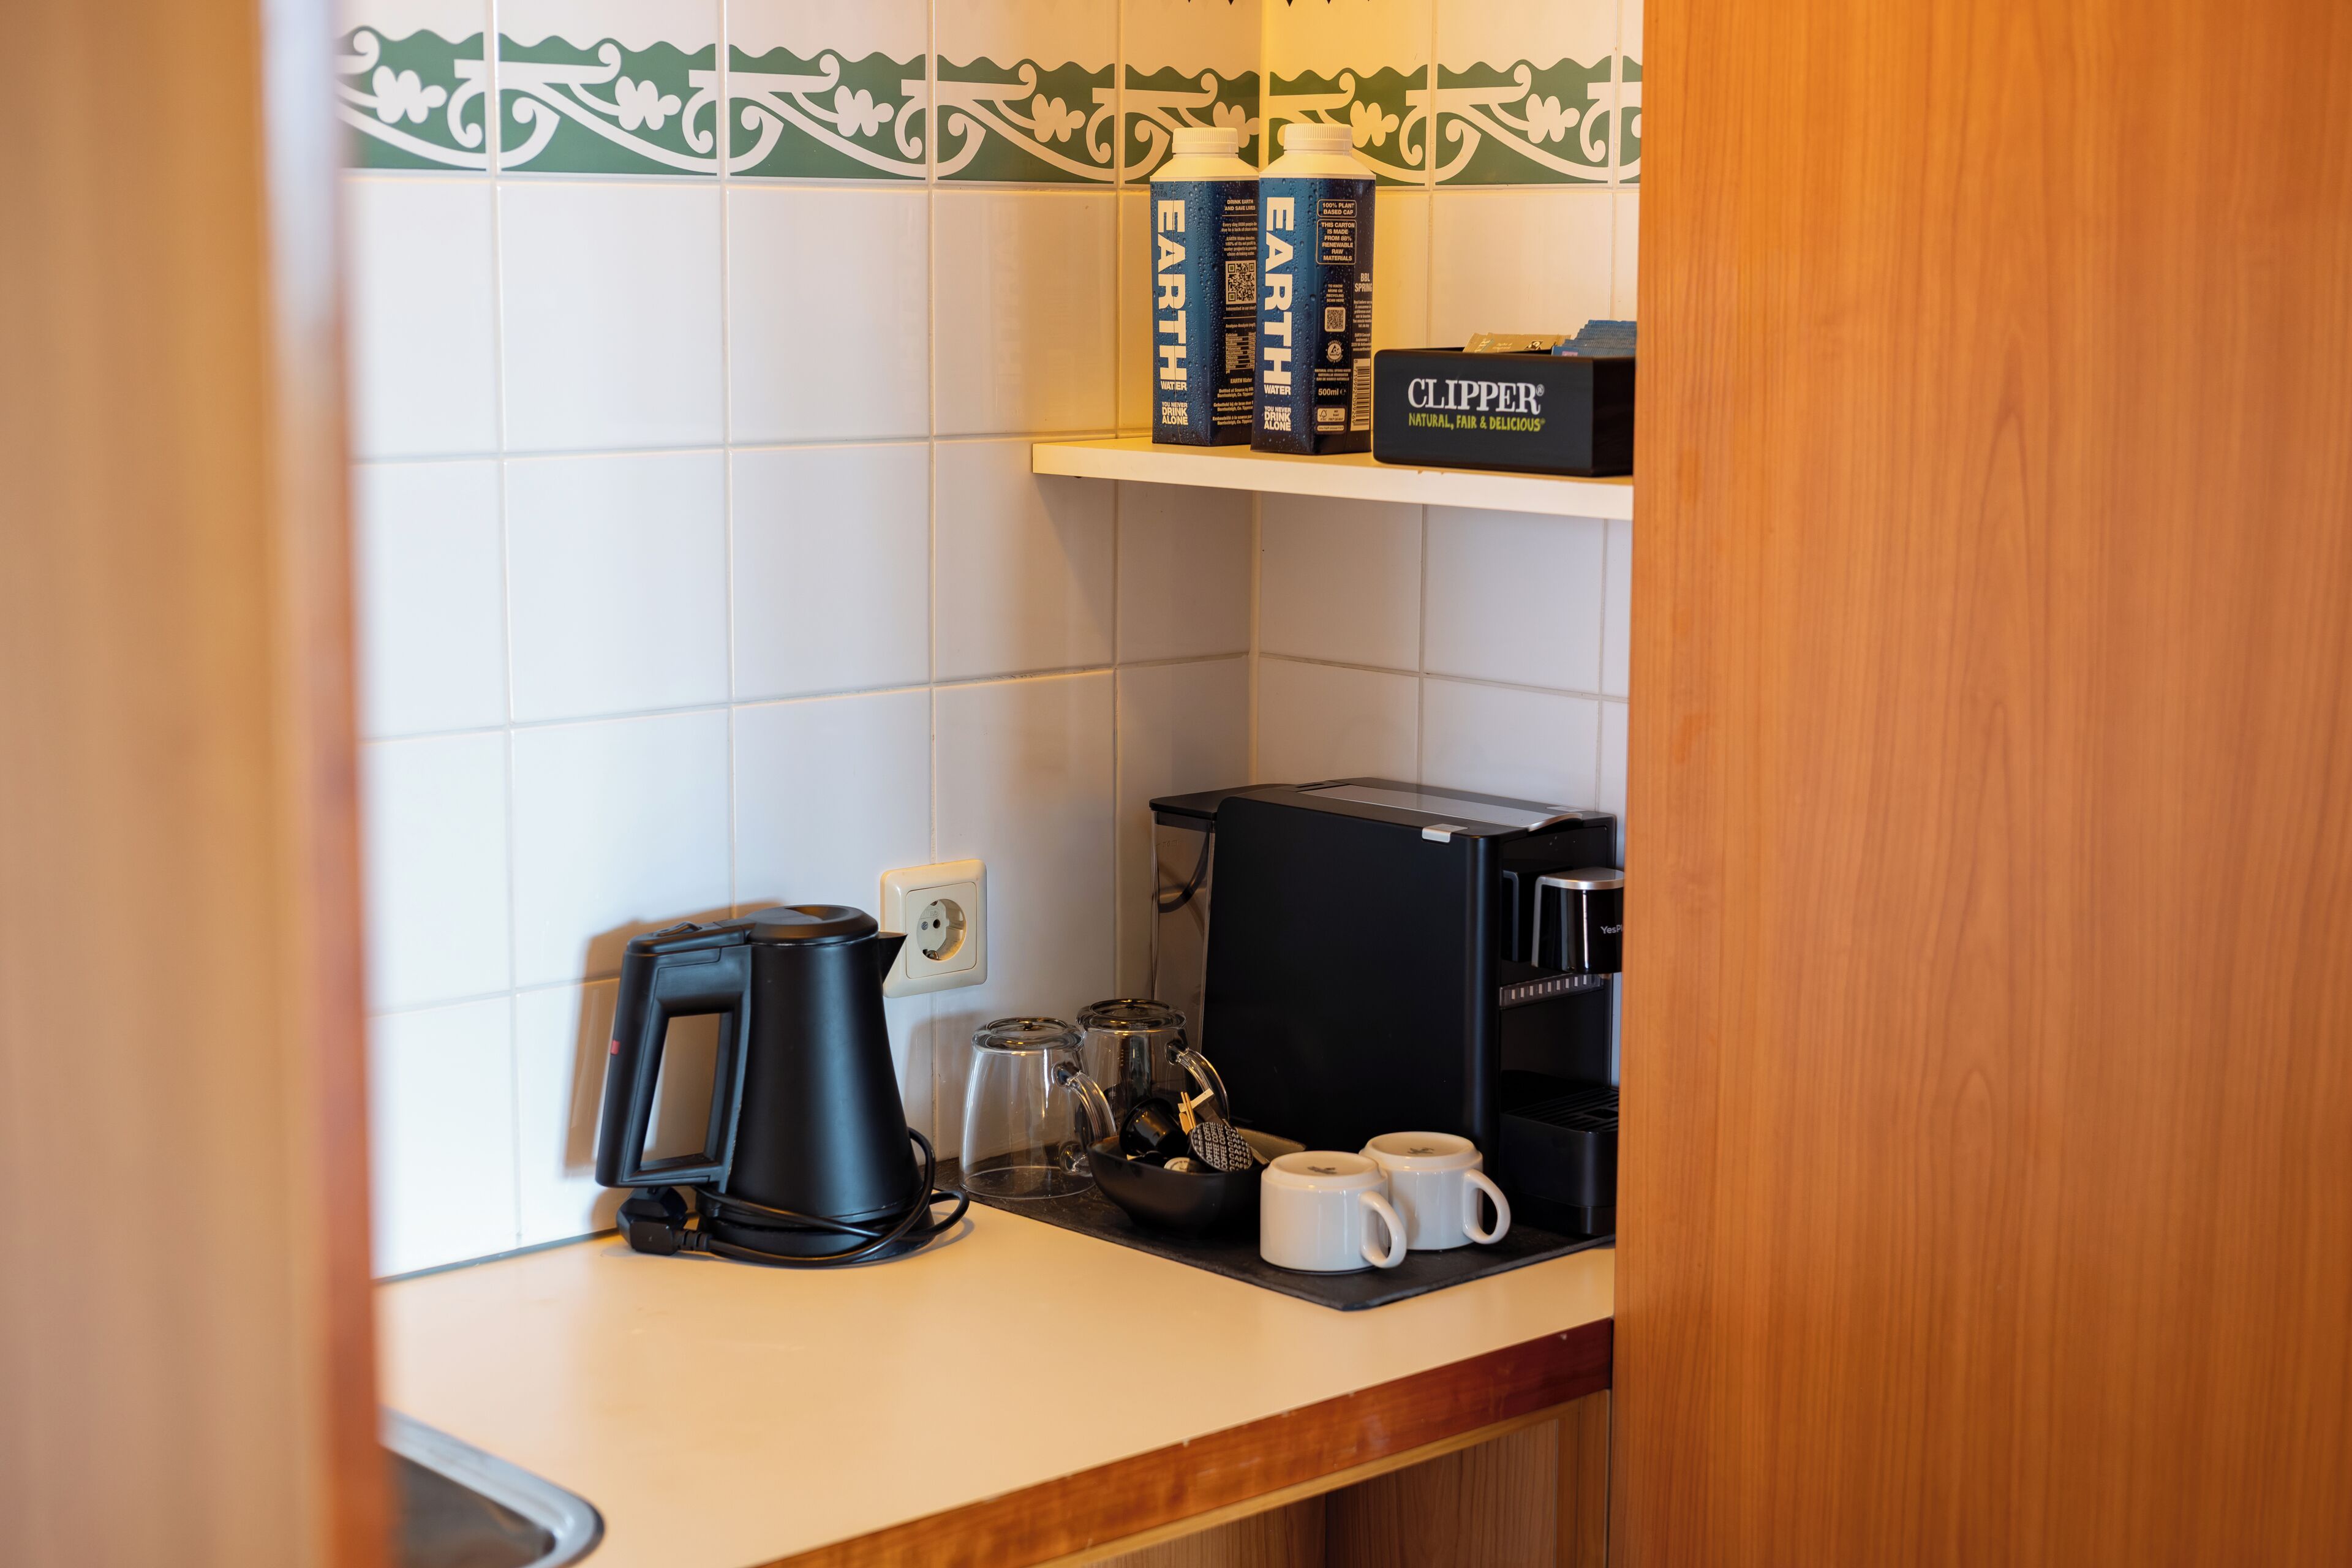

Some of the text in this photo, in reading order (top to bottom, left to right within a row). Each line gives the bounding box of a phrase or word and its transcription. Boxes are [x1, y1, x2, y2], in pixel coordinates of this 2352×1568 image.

[1360, 273, 1371, 282] BBL
[1158, 200, 1187, 380] EARTH
[1264, 197, 1295, 385] EARTH
[1354, 283, 1373, 293] SPRING
[1161, 380, 1187, 391] WATER
[1264, 384, 1291, 396] WATER
[1162, 407, 1188, 417] DRINK
[1264, 411, 1291, 422] DRINK
[1162, 415, 1188, 426] ALONE
[1264, 420, 1292, 432] ALONE
[1409, 412, 1454, 430] NATURAL,
[1457, 415, 1477, 429] FAIR
[1480, 416, 1487, 429] &
[1219, 1145, 1228, 1169] COFFEE
